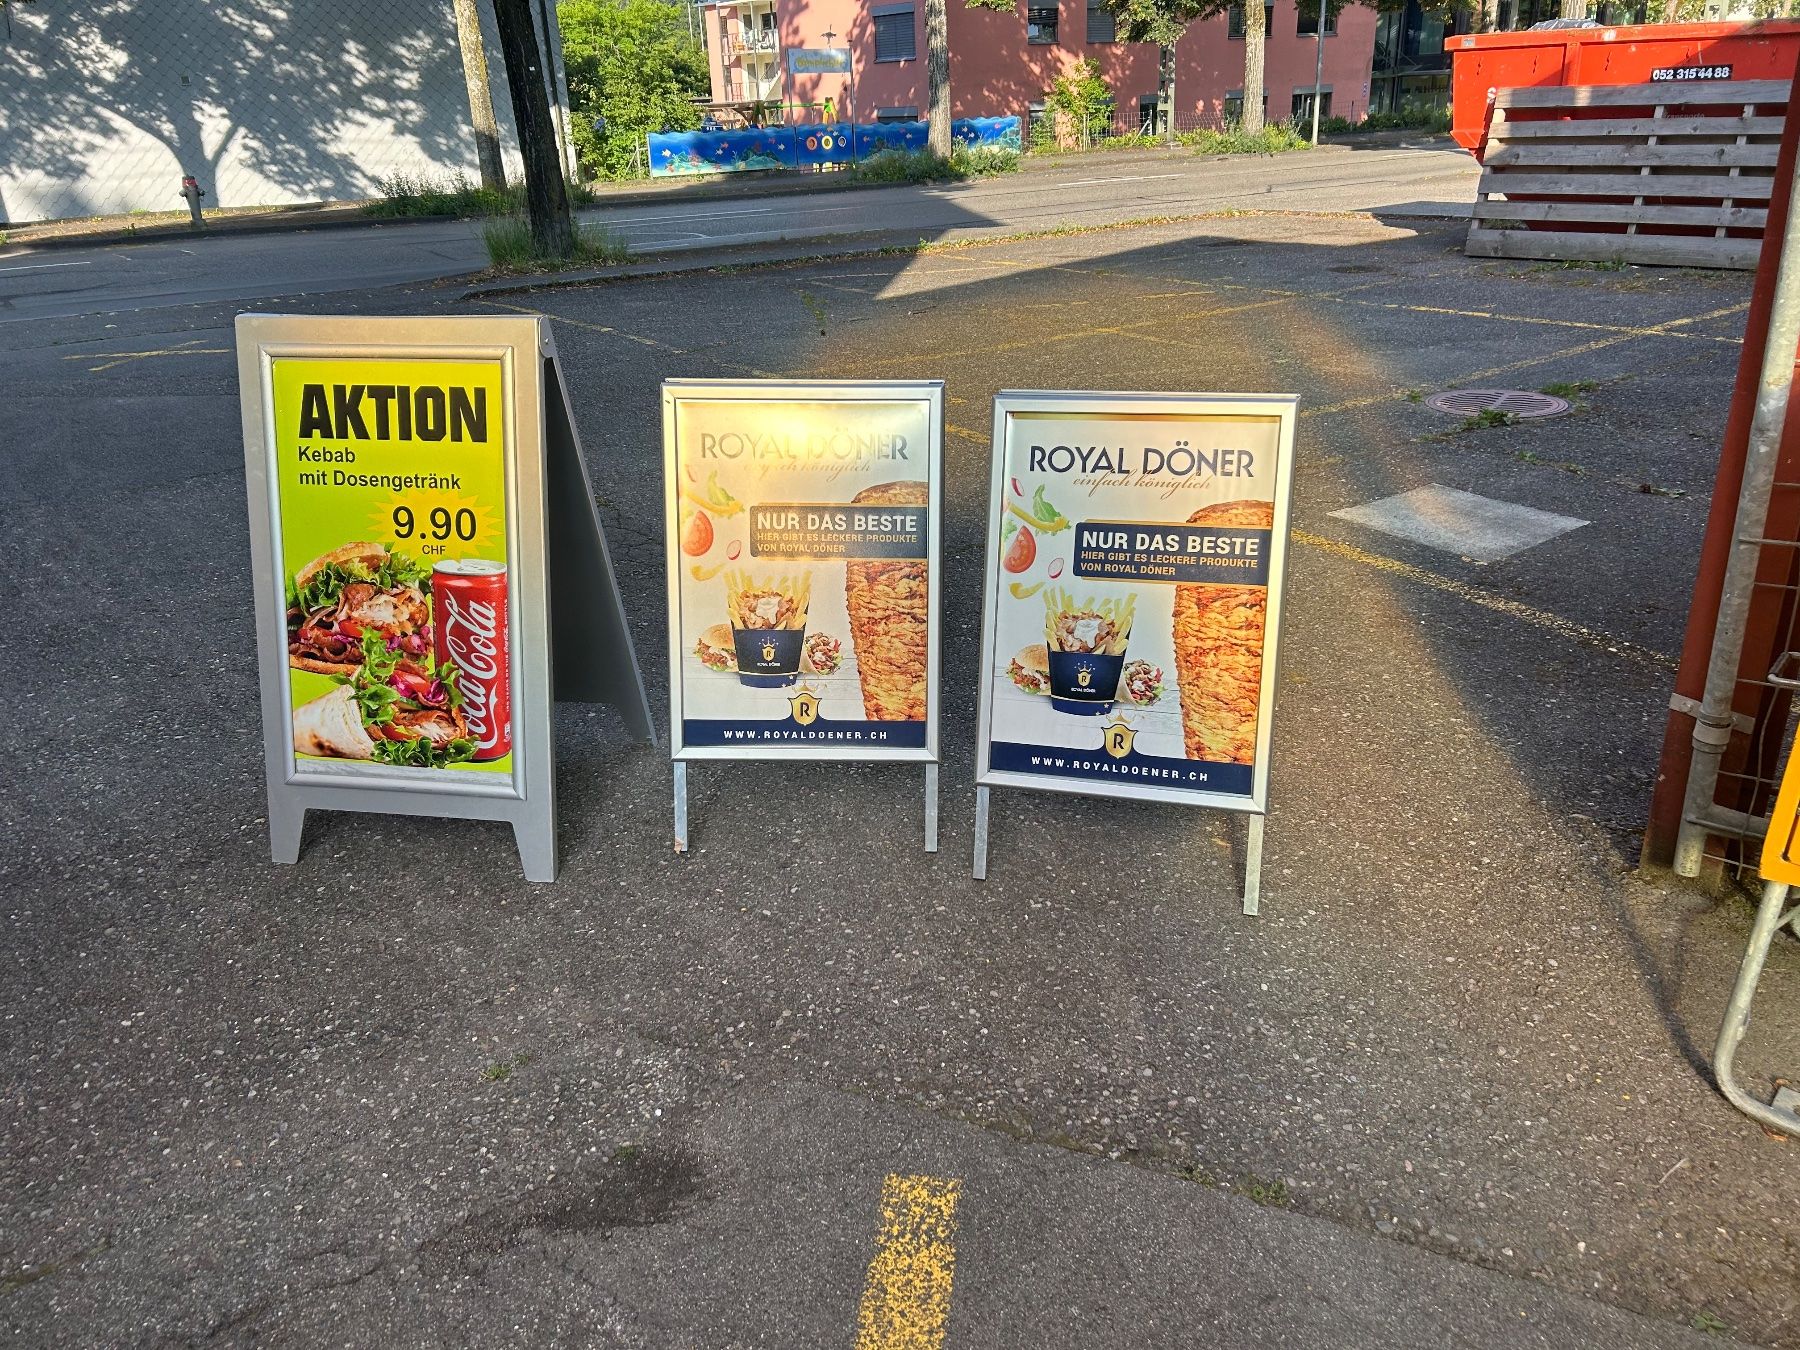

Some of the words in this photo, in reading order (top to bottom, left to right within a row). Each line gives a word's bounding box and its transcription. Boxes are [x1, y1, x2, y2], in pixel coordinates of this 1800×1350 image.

[1652, 69, 1674, 81] 052
[1676, 68, 1697, 80] 315
[1697, 67, 1713, 79] 44
[1714, 66, 1730, 78] 88
[299, 383, 488, 443] AKTION
[700, 432, 797, 460] ROYAL
[807, 426, 909, 461] DÖNER
[298, 446, 356, 463] Kebab
[1029, 445, 1131, 475] ROYAL
[1142, 440, 1254, 478] DÖNER
[299, 470, 328, 486] mit
[333, 470, 462, 492] Dosengetränk
[1073, 468, 1137, 497] einfach
[1133, 470, 1212, 500] königlich
[392, 505, 477, 541] 9.90
[757, 512, 800, 530] NUR
[807, 513, 847, 531] DAS
[854, 514, 918, 532] BESTE
[757, 532, 780, 541] HIER
[782, 533, 804, 542] GIBT
[807, 533, 819, 542] ES
[821, 534, 864, 543] LECKERE
[866, 534, 918, 544] PRODUKTE
[1082, 531, 1128, 549] NUR
[1135, 533, 1180, 551] DAS
[1186, 536, 1260, 556] BESTE
[421, 544, 446, 555] CHF
[757, 543, 777, 552] VON
[779, 543, 811, 553] ROYAL
[812, 542, 847, 553] DÖNER
[1081, 551, 1105, 560] HIER
[1107, 552, 1132, 562] GIBT
[1134, 553, 1148, 562] ES
[1150, 554, 1197, 565] LECKERE
[1200, 556, 1258, 568] PRODUKTE
[1080, 562, 1101, 572] VON
[1104, 564, 1138, 574] ROYAL
[1140, 564, 1176, 576] DÖNER
[445, 588, 498, 749] oca-Cola
[800, 702, 811, 717] R
[724, 730, 887, 740] WWW.ROYALDOENER.CH
[1113, 733, 1125, 750] R
[1031, 756, 1209, 782] WWW.ROYALDOENER.CH
